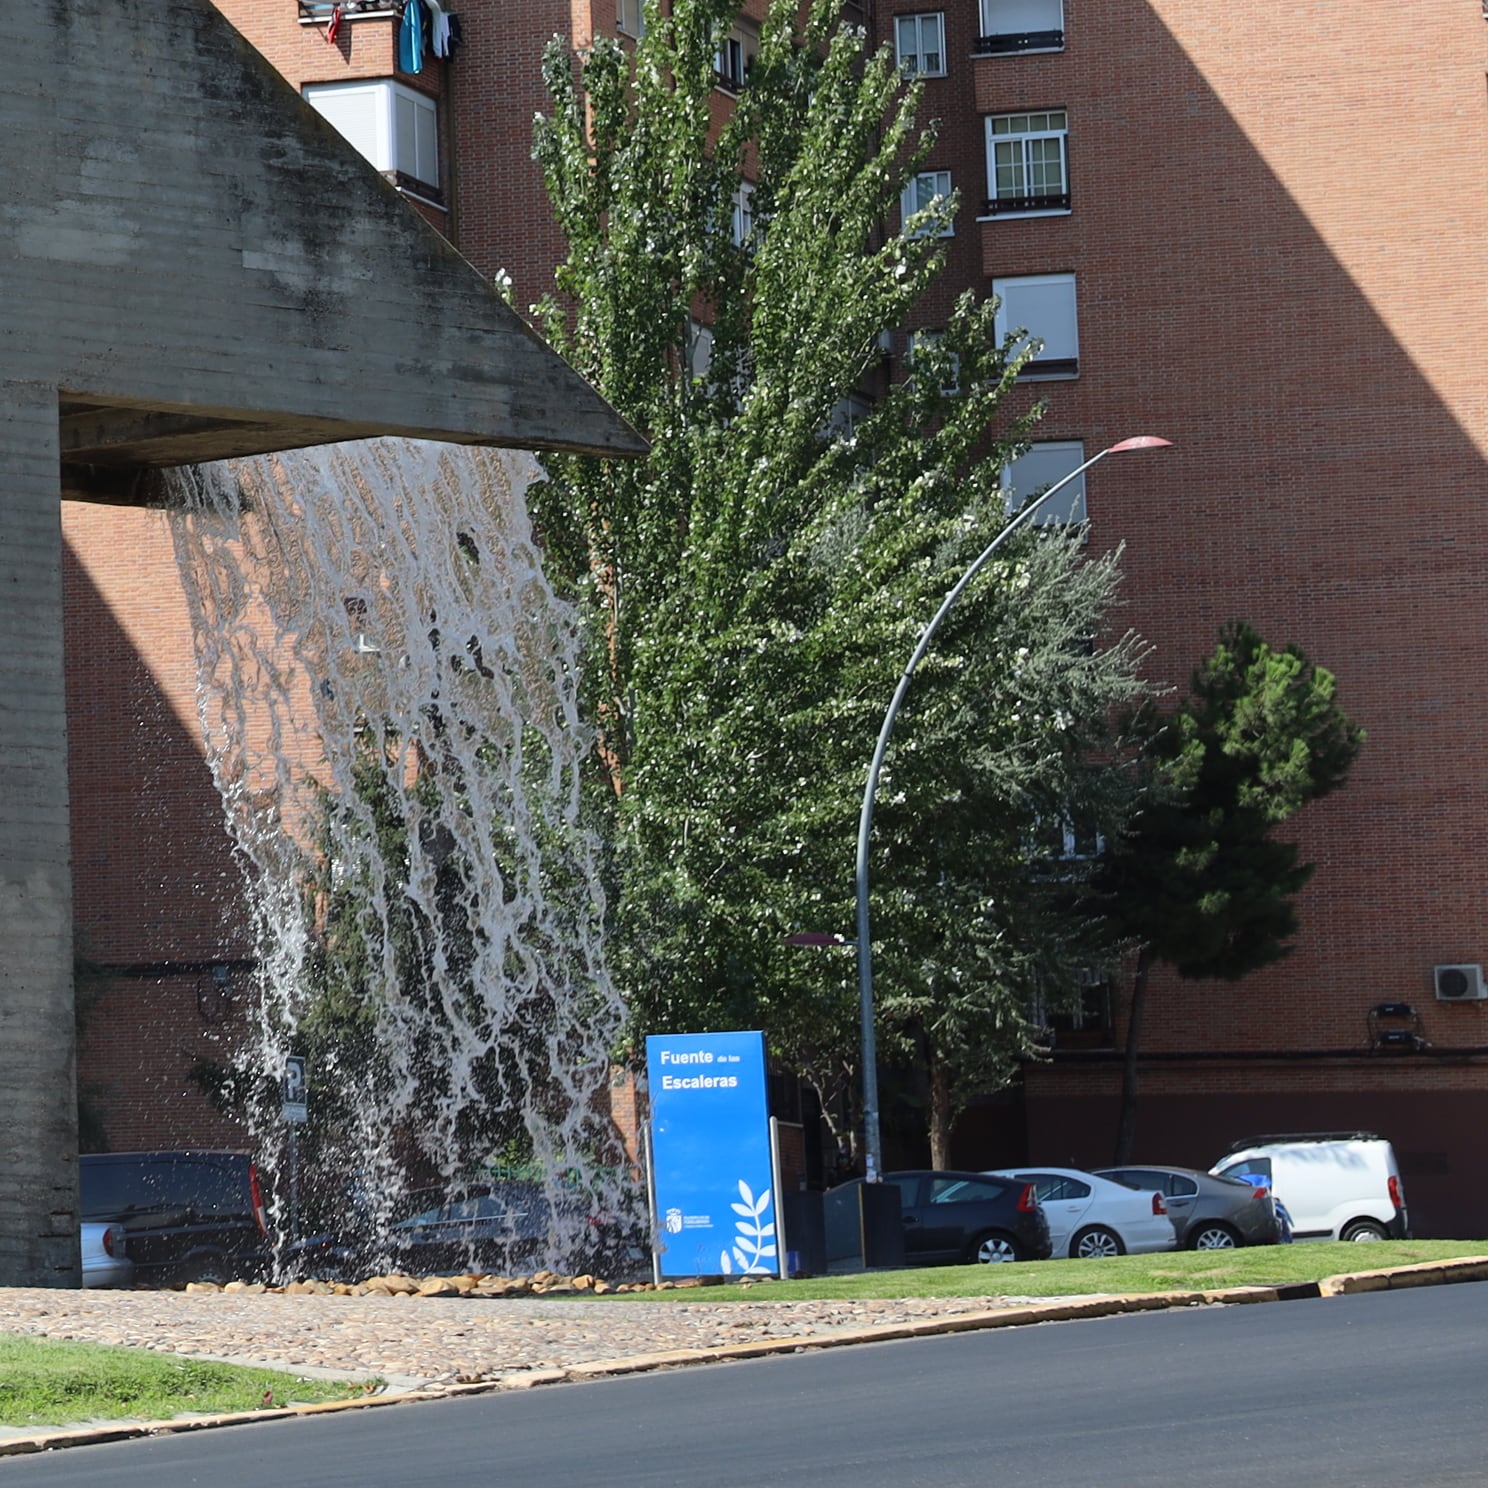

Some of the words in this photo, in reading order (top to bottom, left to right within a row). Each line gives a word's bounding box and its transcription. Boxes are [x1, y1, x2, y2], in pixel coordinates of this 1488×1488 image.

[660, 1050, 713, 1064] Fuente
[287, 1062, 302, 1099] P
[662, 1074, 738, 1090] Escaleras
